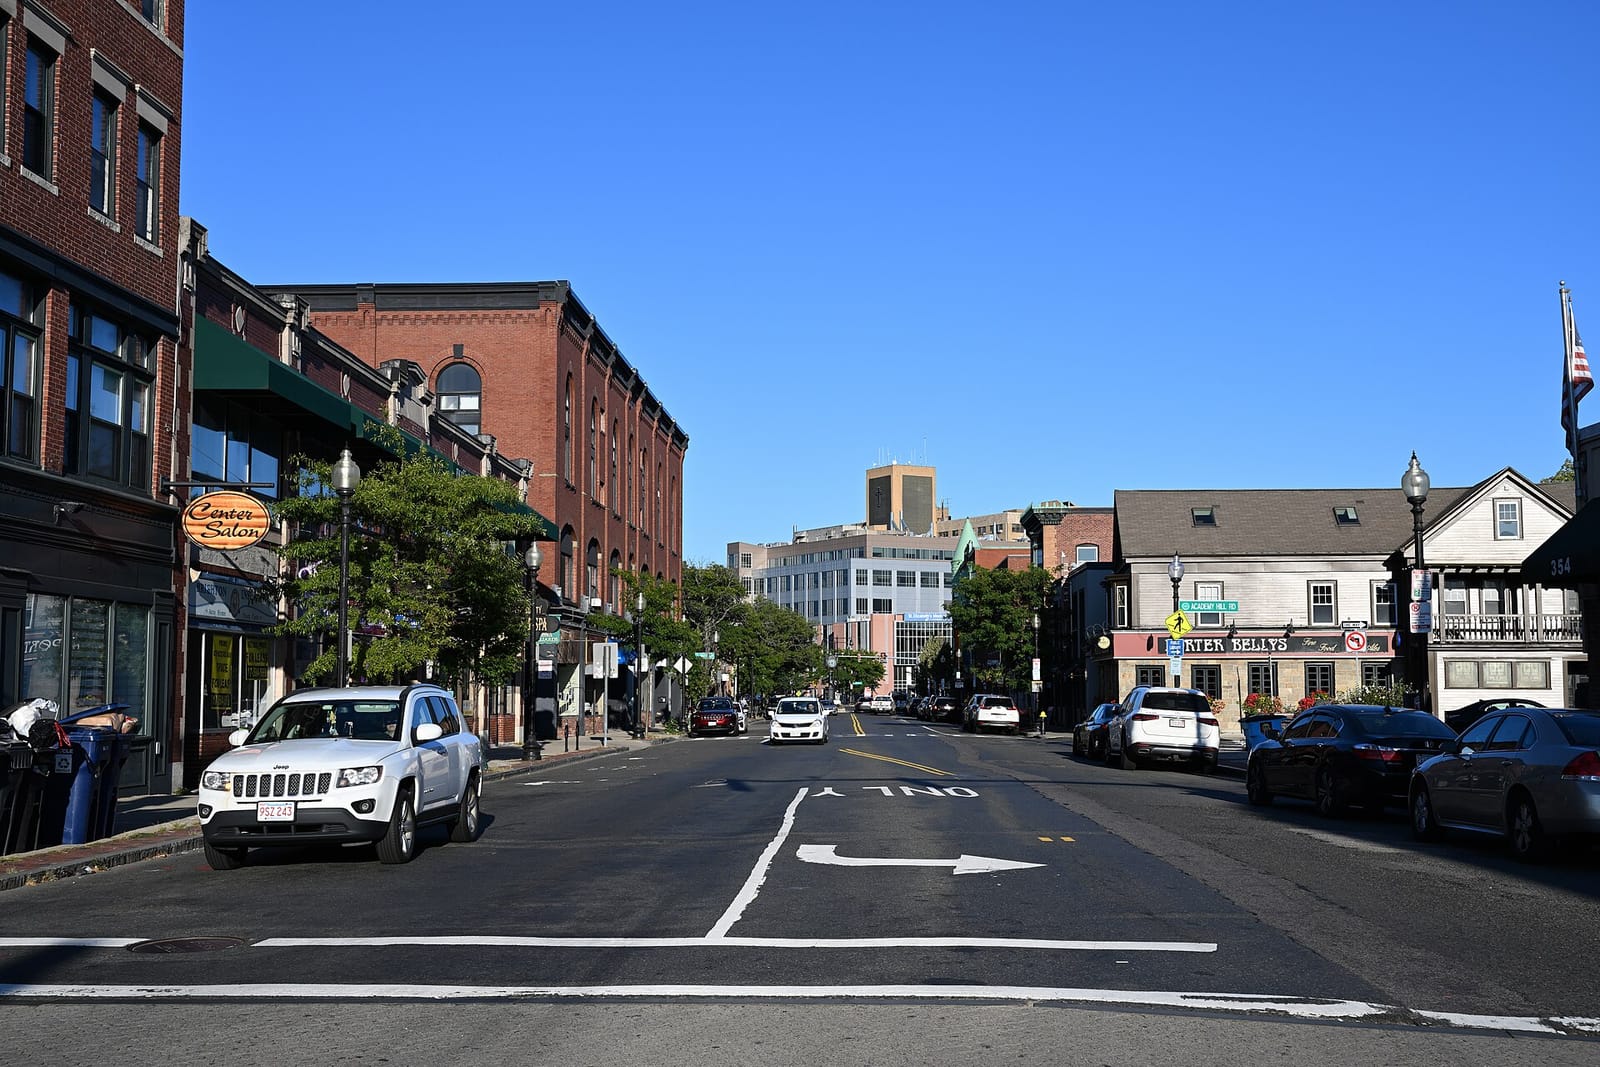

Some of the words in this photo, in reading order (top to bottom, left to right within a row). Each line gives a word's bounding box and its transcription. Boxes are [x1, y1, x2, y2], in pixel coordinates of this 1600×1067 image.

[189, 502, 253, 520] Center
[200, 520, 259, 538] Salon
[1550, 556, 1571, 576] 354
[1191, 602, 1215, 610] ACADEMY
[1216, 602, 1226, 610] HILL
[1165, 639, 1224, 652] RTER
[1231, 638, 1288, 652] BELLYS
[811, 786, 980, 798] ONLY
[276, 806, 292, 816] 243
